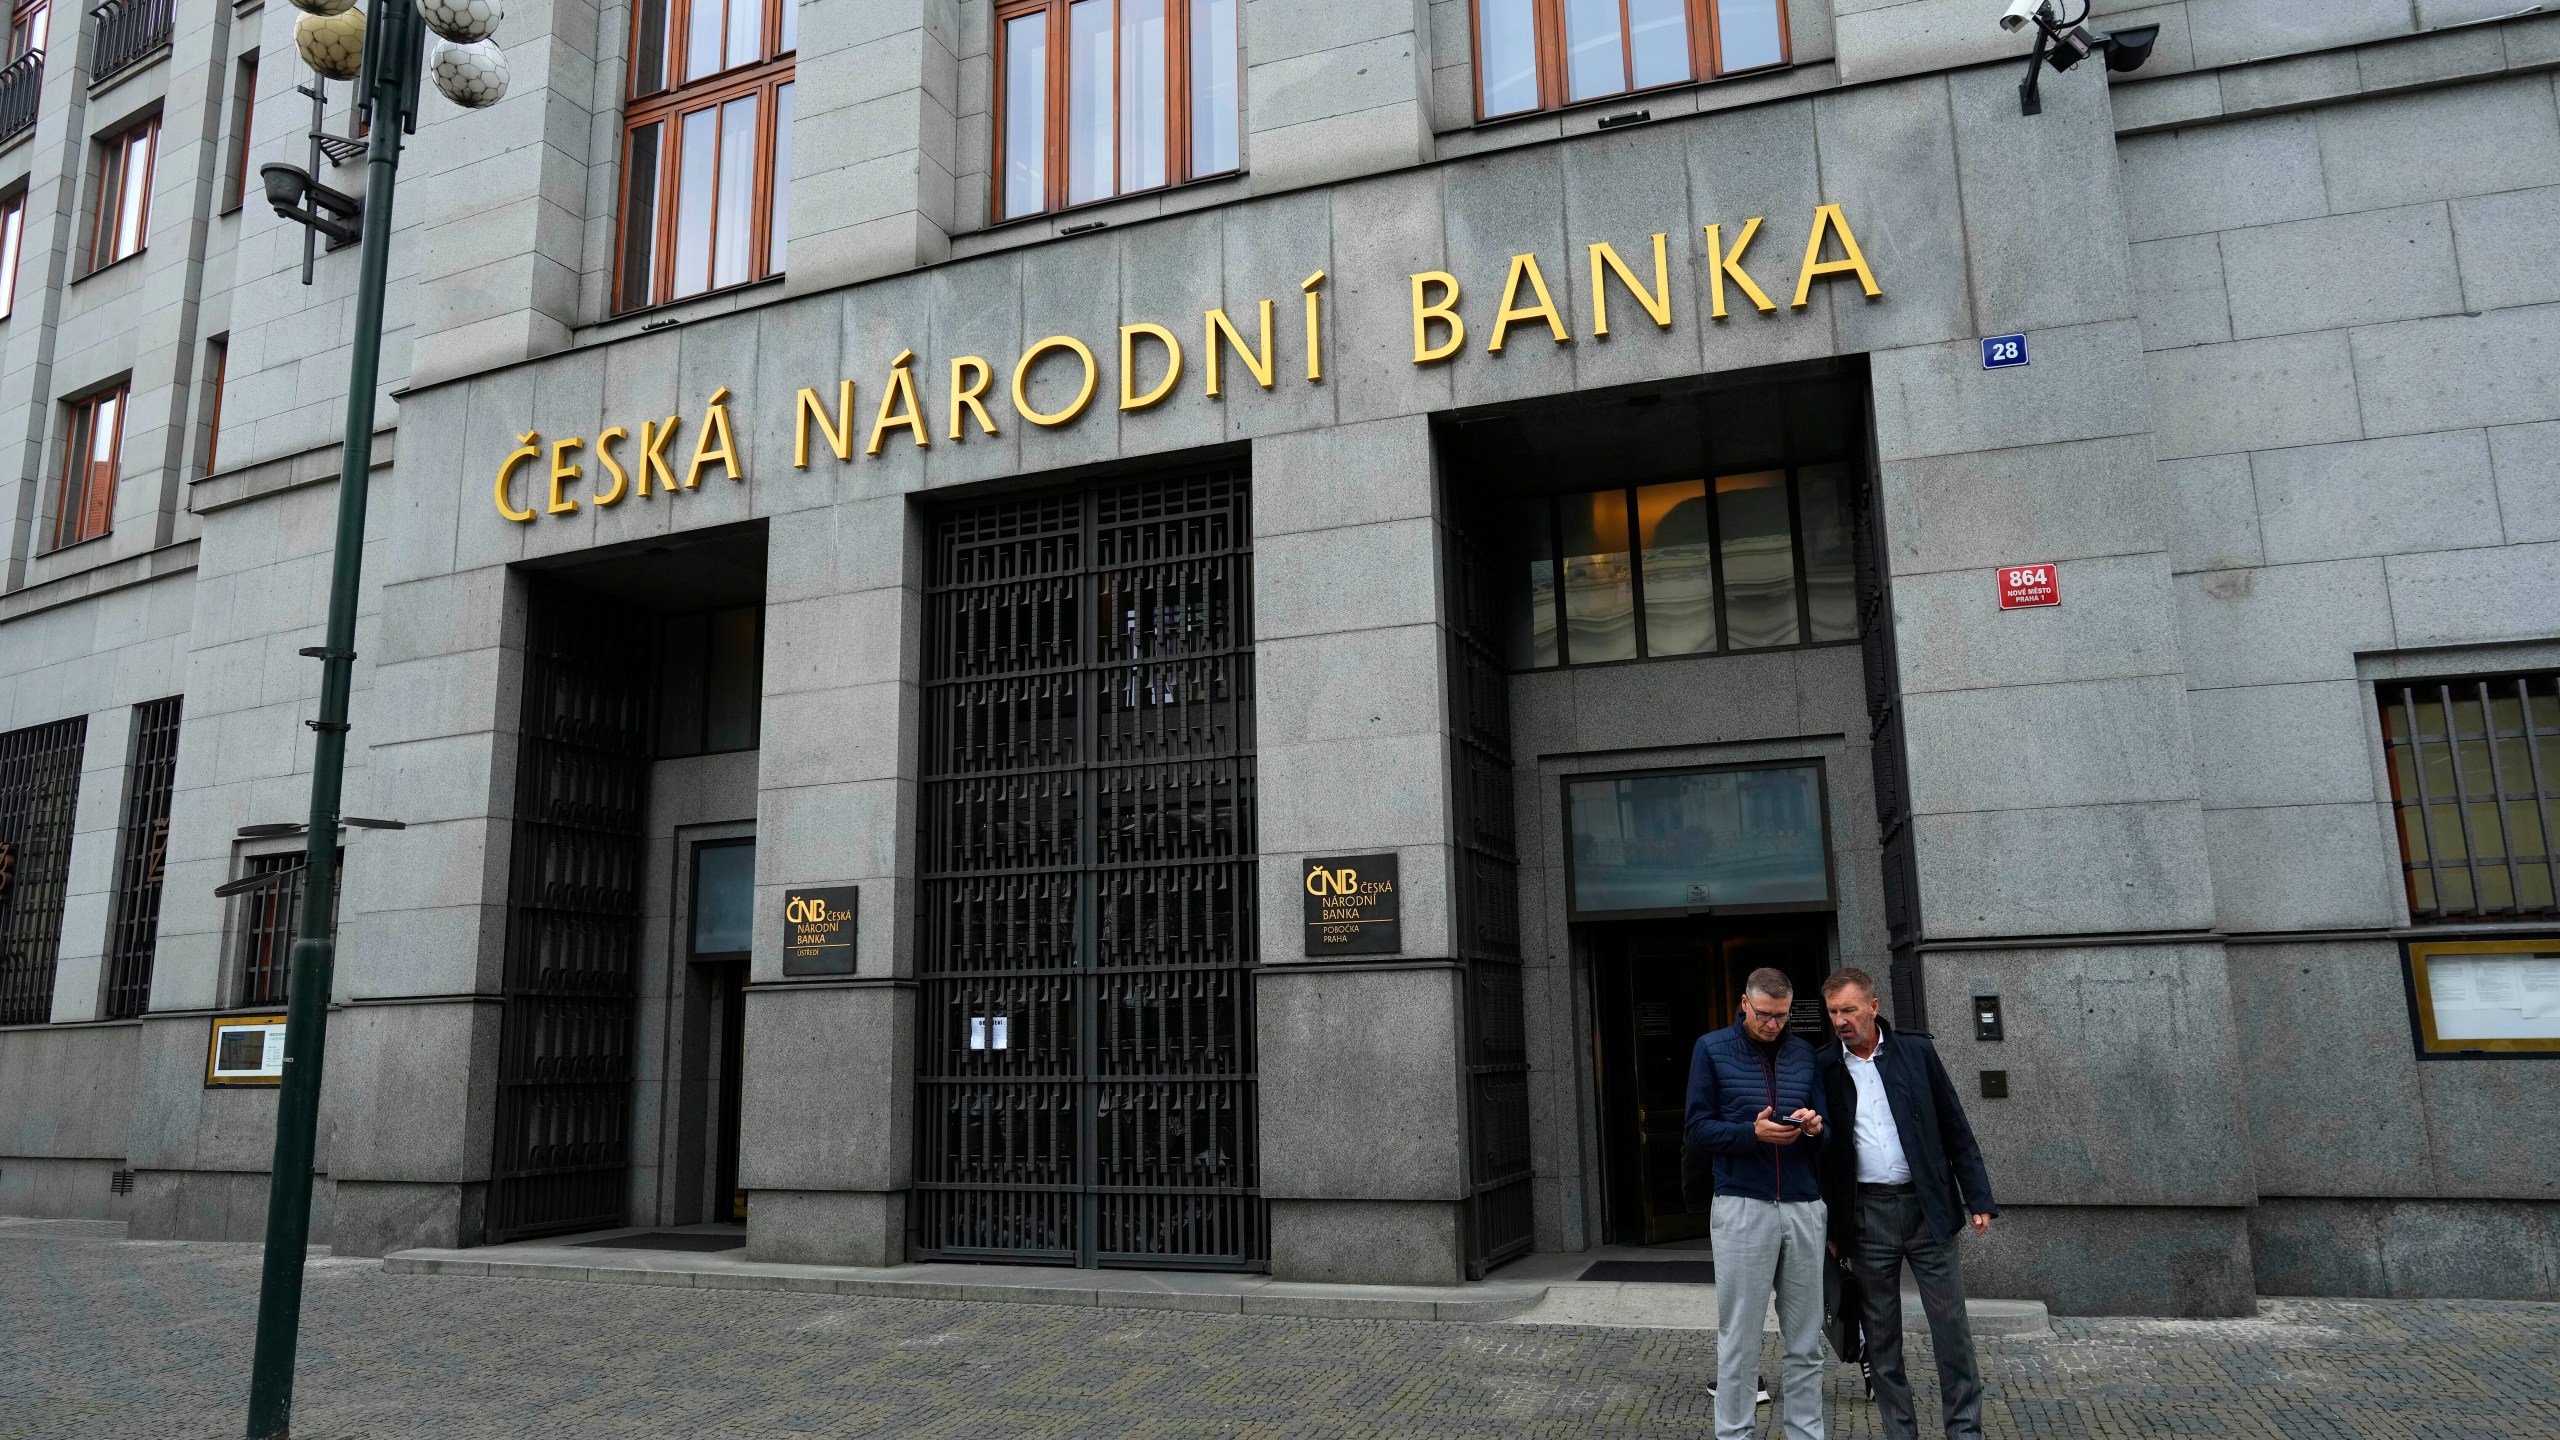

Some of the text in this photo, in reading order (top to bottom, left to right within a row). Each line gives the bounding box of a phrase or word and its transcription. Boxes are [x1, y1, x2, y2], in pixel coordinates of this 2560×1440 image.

[1992, 341, 2019, 361] 28
[494, 203, 1884, 523] ČESKÁ NÁRODNÍ BANKA
[2009, 568, 2048, 587] 864
[2007, 586, 2052, 597] NOVÉ MĚSTO
[2015, 594, 2040, 603] PRAHA
[1306, 865, 1393, 896] ČNB ČESKÁ
[1322, 893, 1376, 908] NÁRODNÍ
[786, 896, 852, 923] ČNB ČESKÁ
[1322, 908, 1360, 920] BANKA
[798, 921, 839, 933] NÁRODNÍ
[1323, 924, 1360, 934] POBOČKA
[798, 935, 825, 944] BANKA
[1323, 935, 1348, 943] PRAHA
